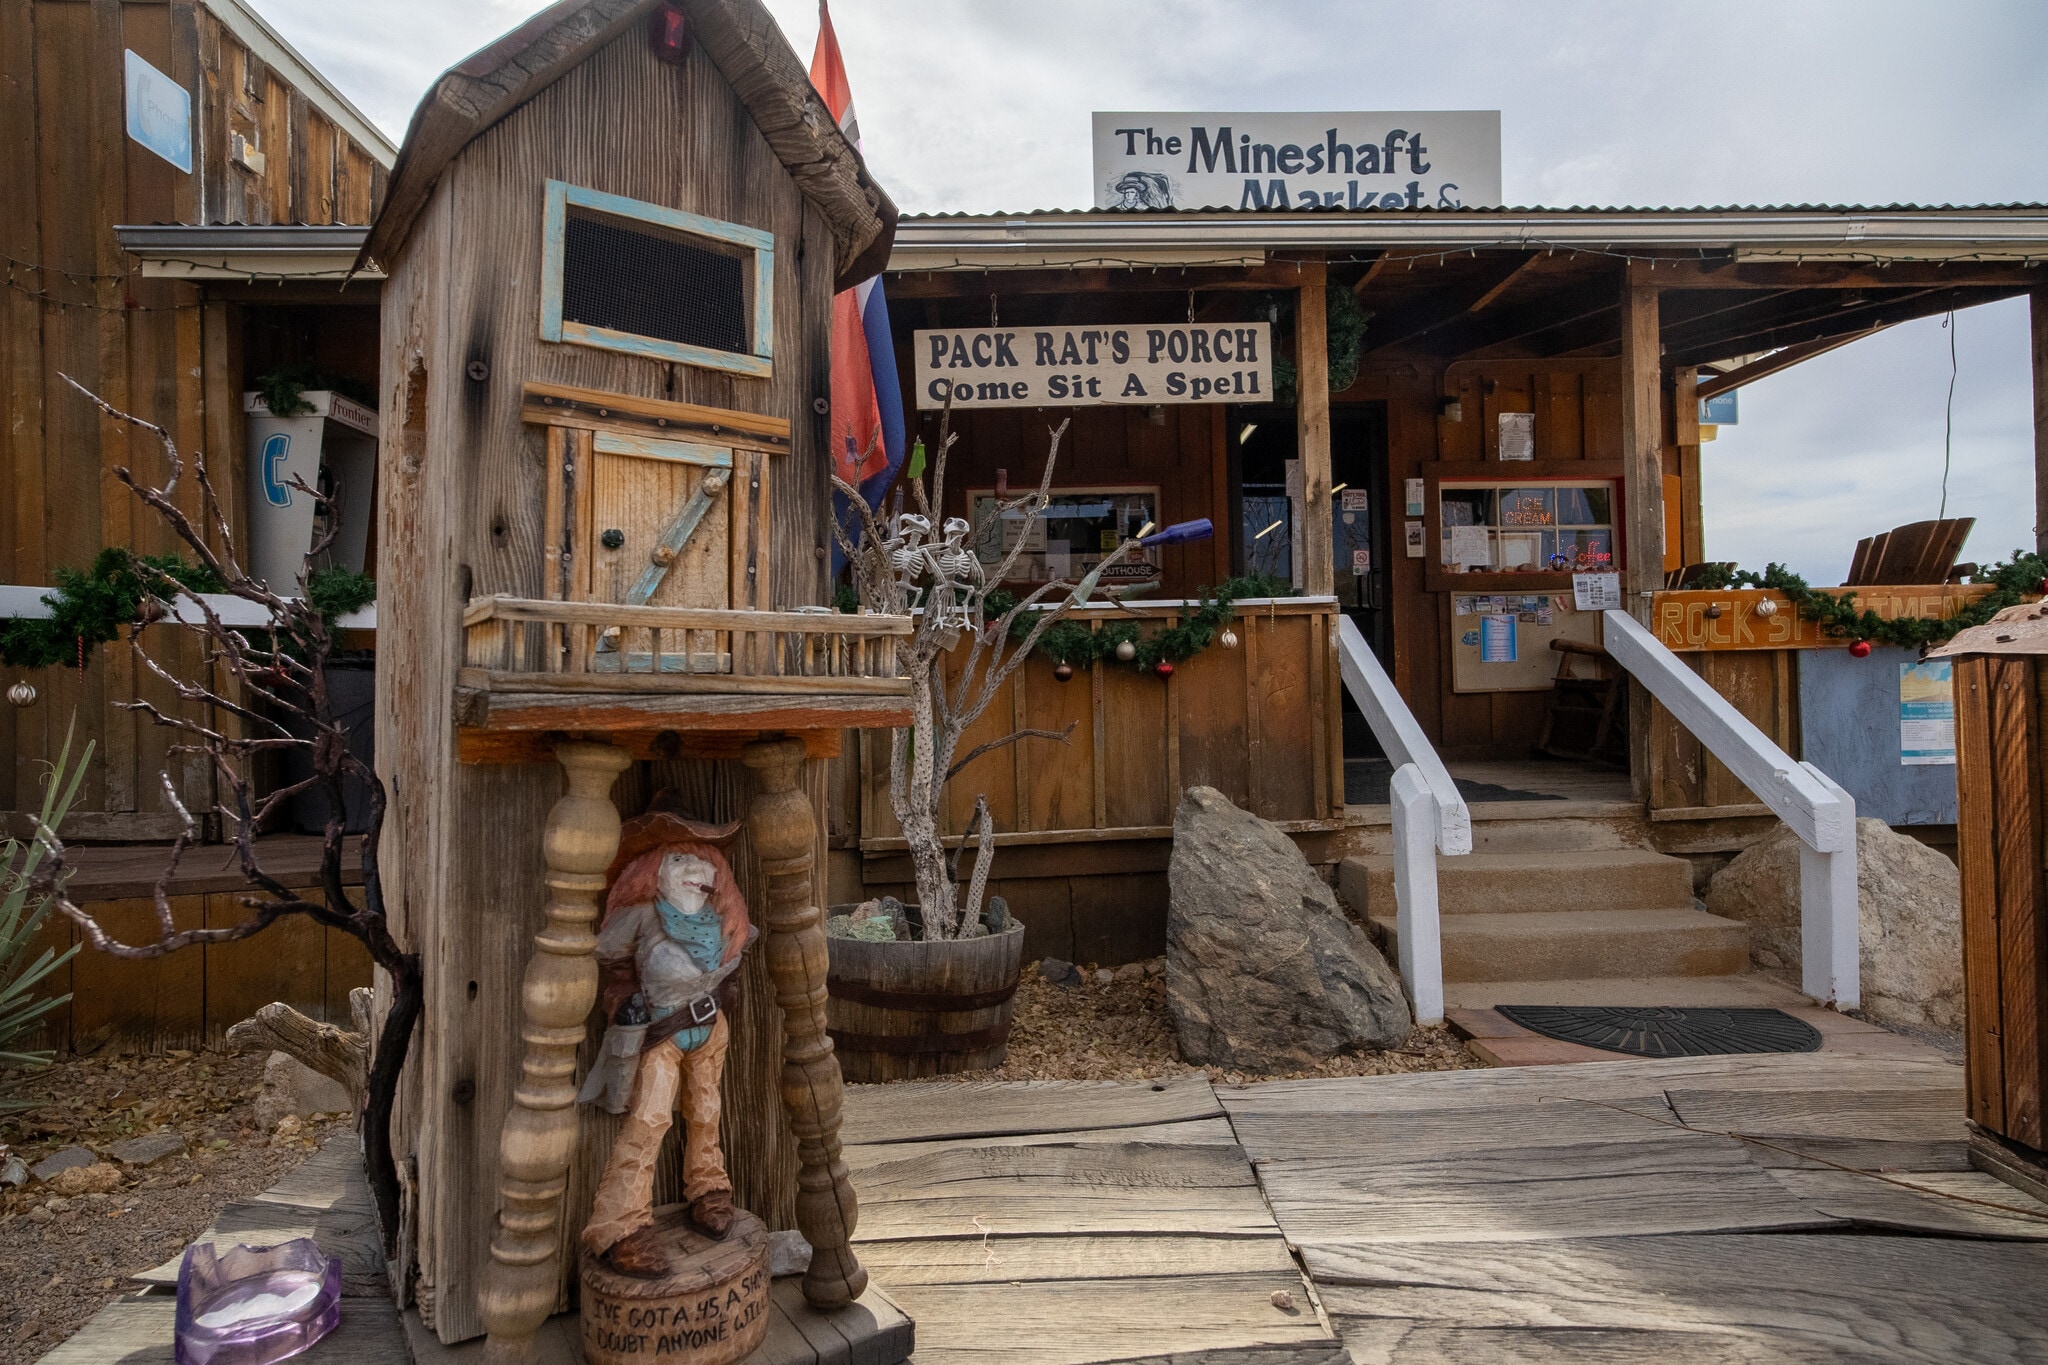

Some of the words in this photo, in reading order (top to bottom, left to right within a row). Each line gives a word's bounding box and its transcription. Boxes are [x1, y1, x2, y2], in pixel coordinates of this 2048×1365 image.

[1115, 128, 1182, 156] The
[1186, 126, 1431, 175] Mineshaft
[1239, 179, 1425, 210] Market
[928, 332, 1019, 369] PACK
[1034, 330, 1131, 366] RAT'S
[1146, 328, 1258, 364] PORCH
[928, 377, 1029, 401] Come
[1048, 374, 1102, 398] Sit
[1121, 372, 1148, 397] A
[1166, 371, 1261, 400] Spell
[331, 397, 371, 426] frontier
[1505, 511, 1551, 524] CREAM
[1517, 497, 1543, 510] ICE
[1566, 541, 1611, 566] Coffee
[1101, 566, 1153, 576] OUTHOUSE
[1661, 601, 1755, 644] ROCK
[594, 1298, 621, 1323] I'VE
[629, 1308, 668, 1329] GOT
[672, 1306, 689, 1326] A
[726, 1288, 741, 1310] A
[597, 1327, 647, 1353] DOUBT
[655, 1320, 729, 1356] ANYONE
